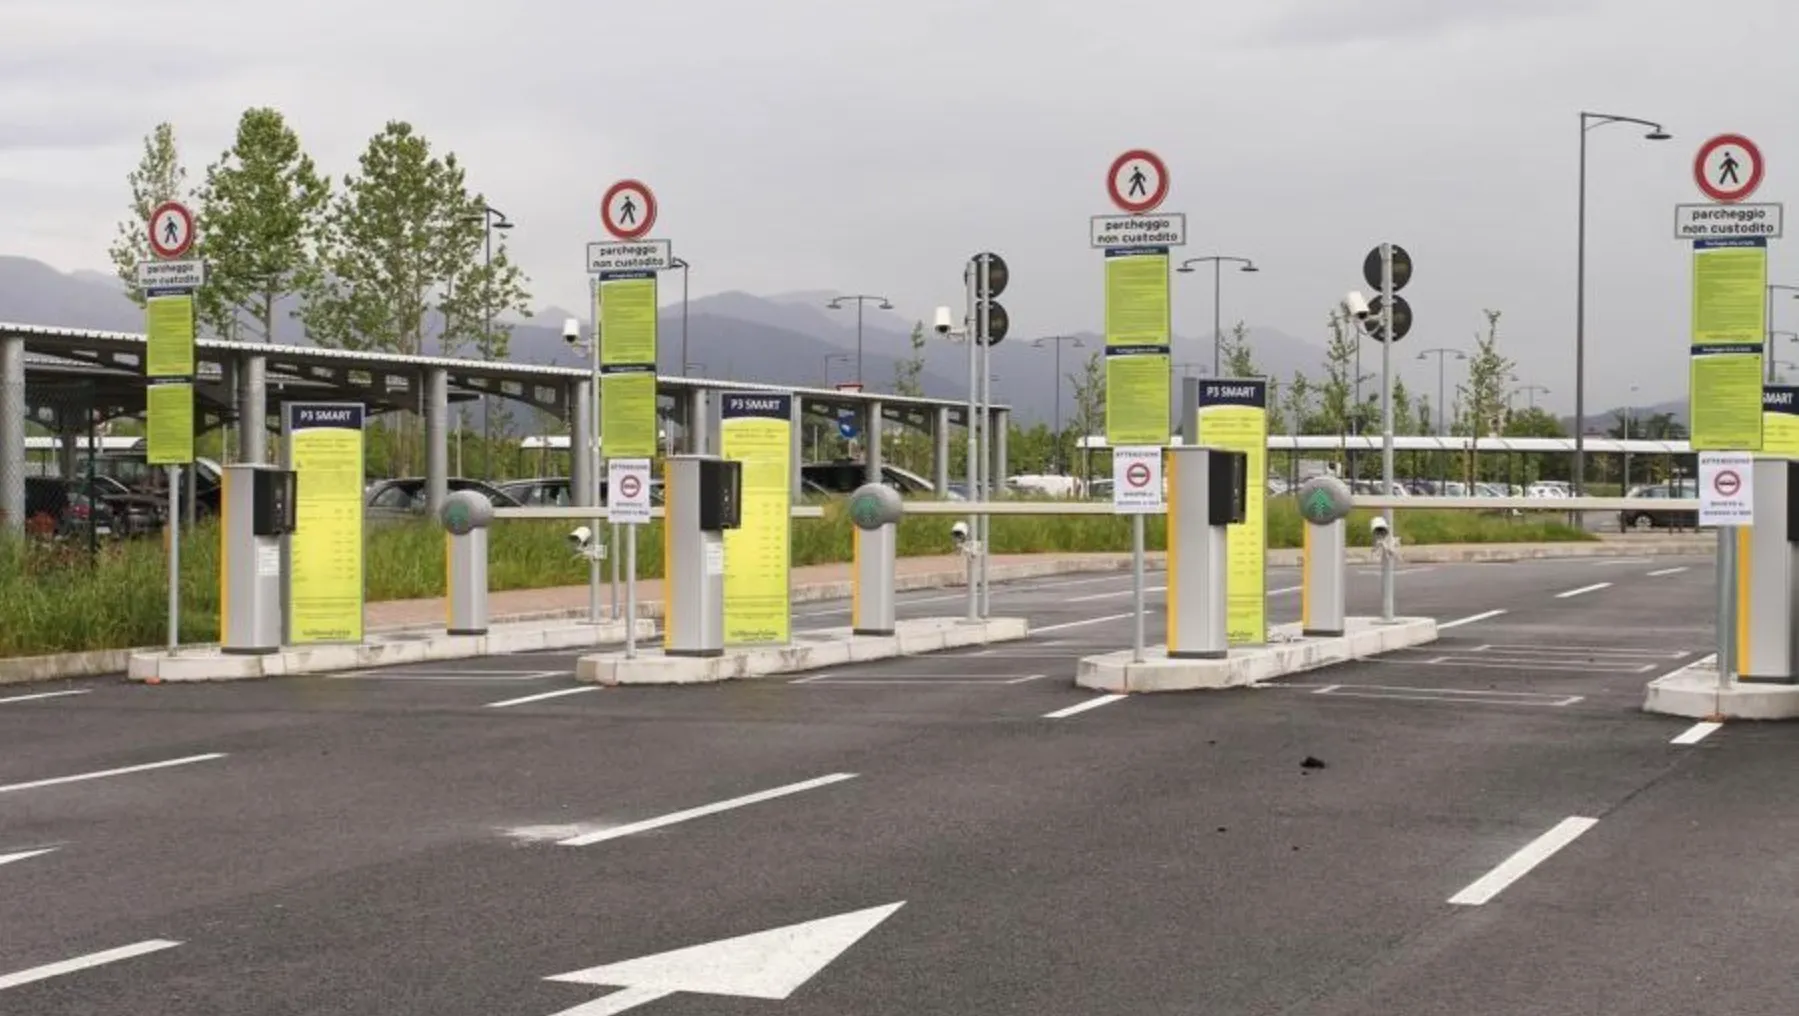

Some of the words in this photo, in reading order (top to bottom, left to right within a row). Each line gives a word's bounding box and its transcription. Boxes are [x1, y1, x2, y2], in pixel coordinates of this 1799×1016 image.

[1692, 208, 1766, 221] parcheggio
[1105, 218, 1170, 231] parcheggio
[1682, 223, 1707, 234] non
[1710, 221, 1774, 234] custodito
[1098, 234, 1119, 243] non
[1122, 232, 1178, 243] custodito
[600, 245, 657, 257] parcheggio
[592, 260, 612, 268] non
[614, 257, 664, 268] custodito
[1206, 386, 1220, 398] P3
[1220, 386, 1256, 398] SMART
[730, 398, 744, 410] P3
[745, 399, 781, 411] SMART
[300, 410, 314, 421] P3
[315, 410, 352, 421] SMART
